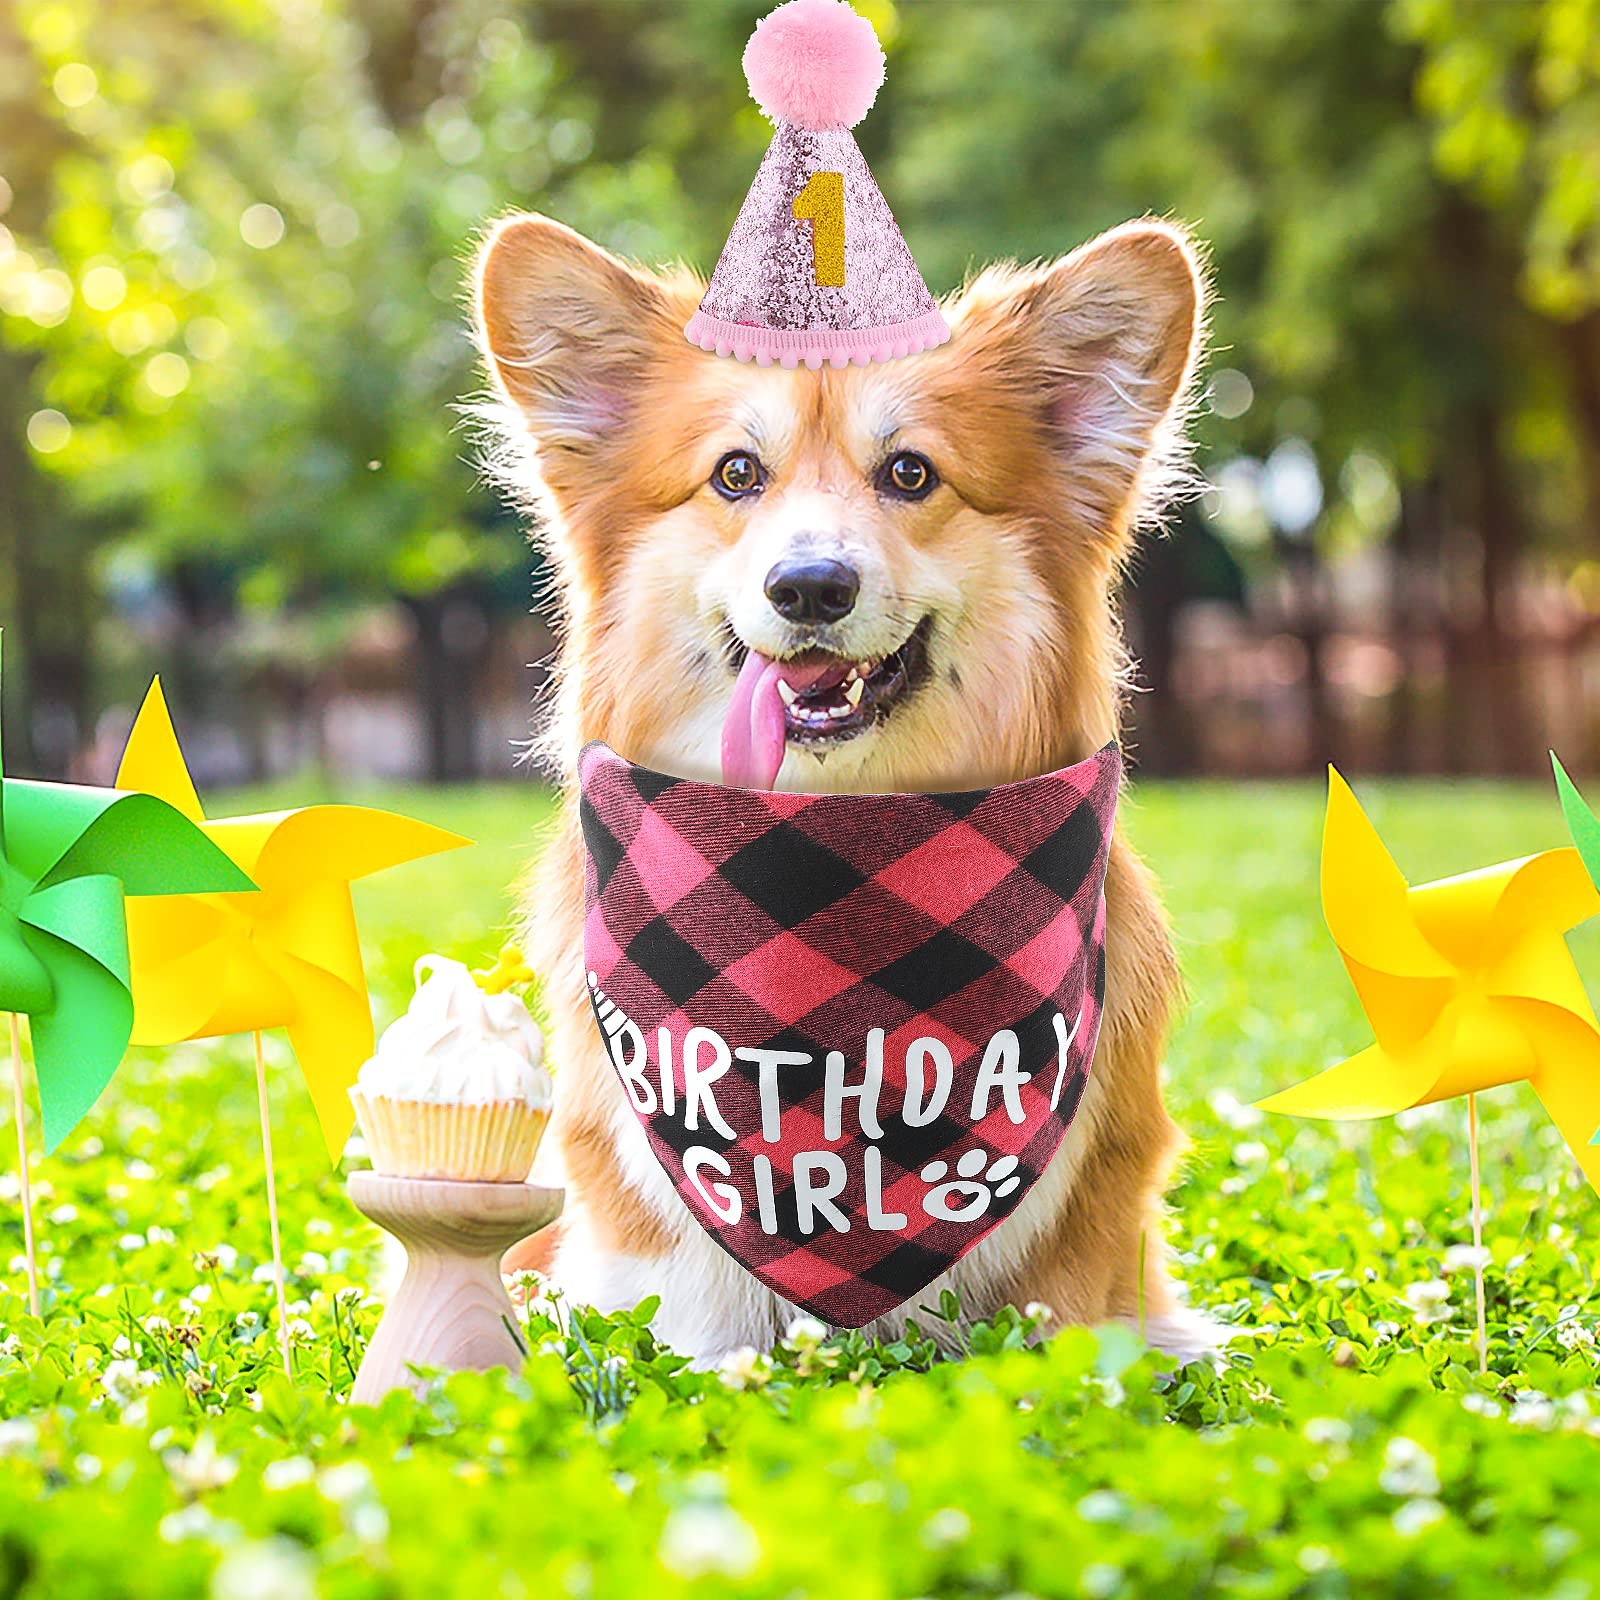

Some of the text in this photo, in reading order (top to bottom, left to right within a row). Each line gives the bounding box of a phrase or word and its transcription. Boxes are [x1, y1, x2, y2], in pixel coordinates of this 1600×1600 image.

[792, 171, 845, 286] 1
[609, 1010, 1083, 1143] BIRTHDAY
[682, 1145, 908, 1235] GIRL
